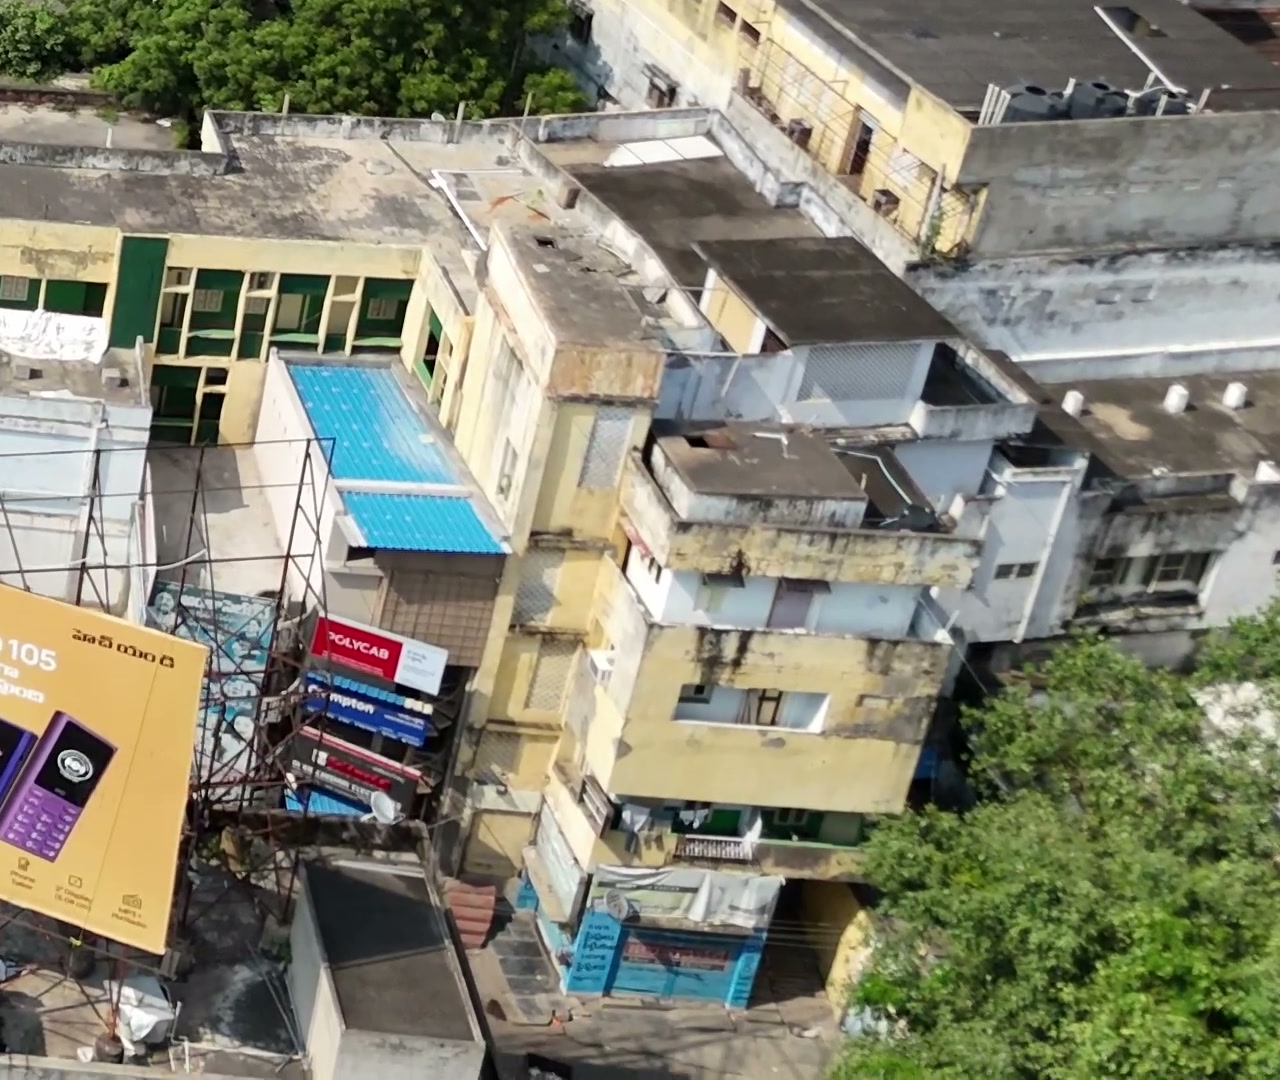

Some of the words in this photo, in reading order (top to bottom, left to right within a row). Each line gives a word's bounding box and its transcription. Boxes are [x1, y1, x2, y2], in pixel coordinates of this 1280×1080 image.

[8, 639, 57, 671] 105
[328, 631, 390, 660] POLYCAB
[308, 684, 375, 715] Crmpton
